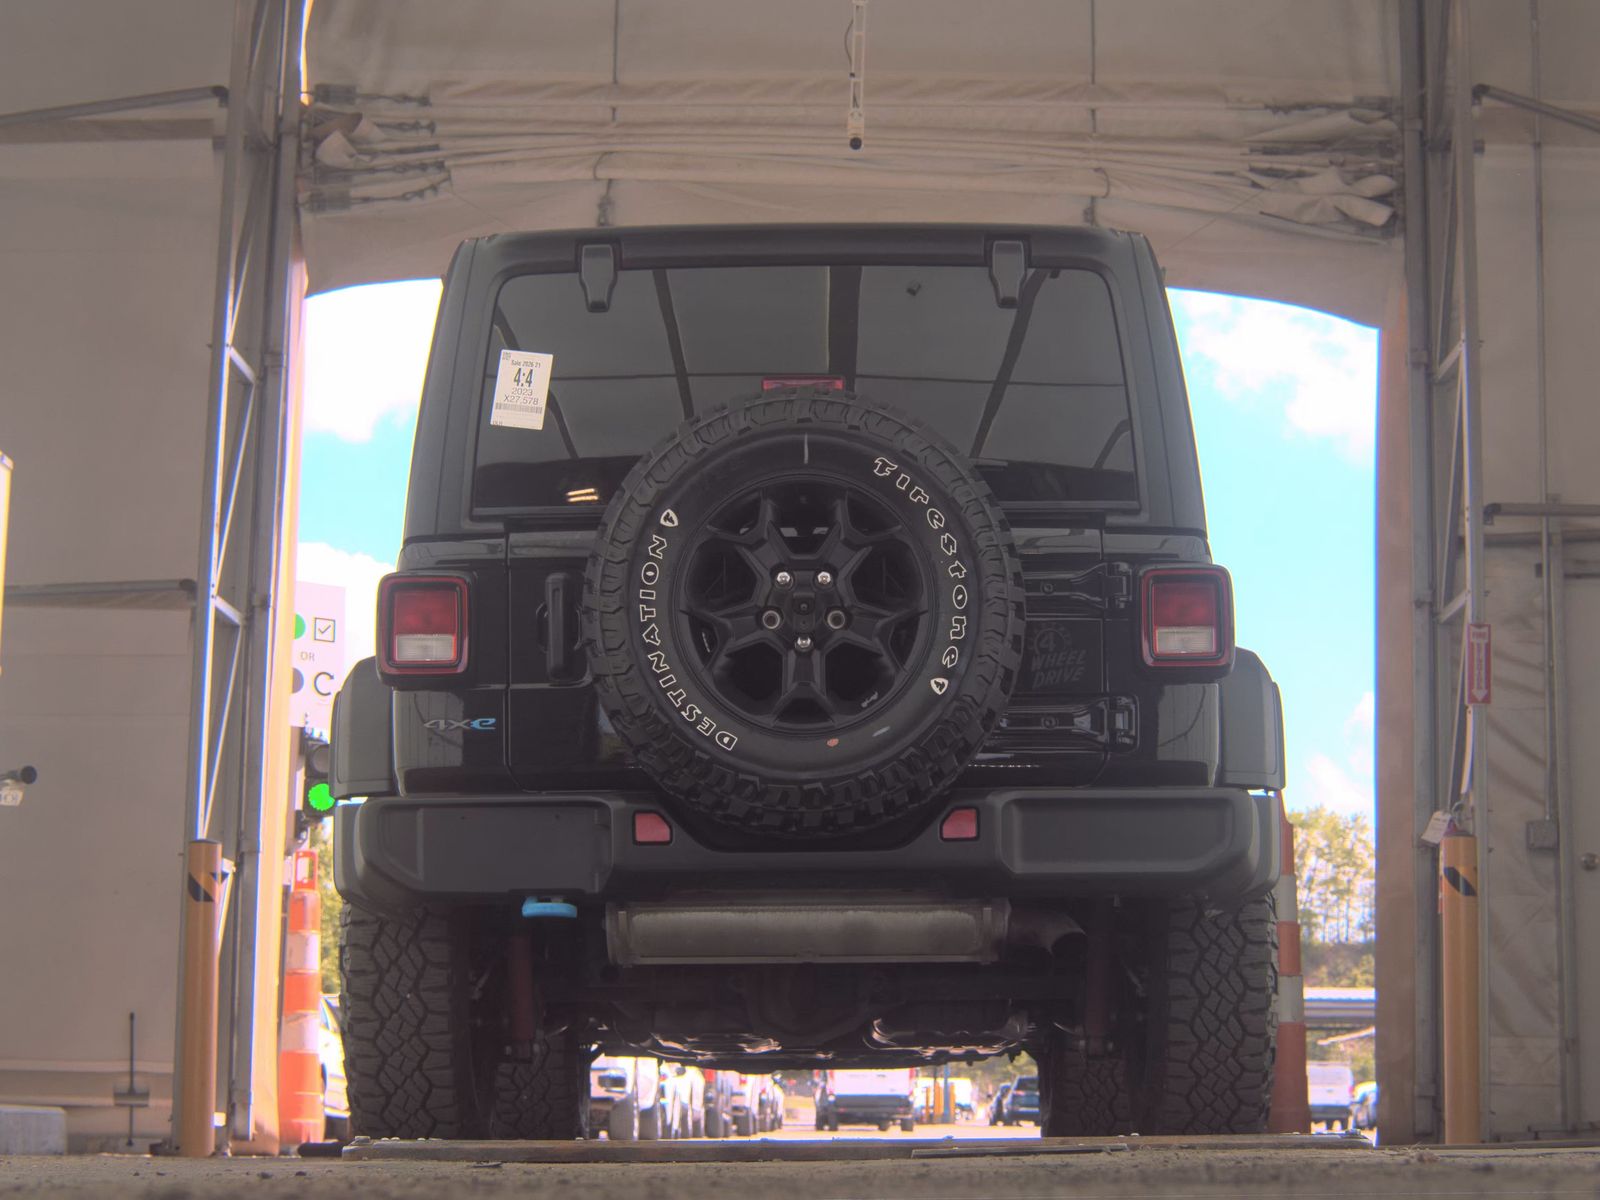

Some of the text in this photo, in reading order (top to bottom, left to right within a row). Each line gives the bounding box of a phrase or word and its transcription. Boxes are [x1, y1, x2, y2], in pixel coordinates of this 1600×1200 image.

[511, 387, 533, 396] 2023
[872, 456, 968, 669] Firestone
[639, 534, 738, 751] DESTINATION
[300, 651, 315, 662] OR
[1031, 649, 1087, 672] WHEEL
[1032, 666, 1085, 689] DRIVE
